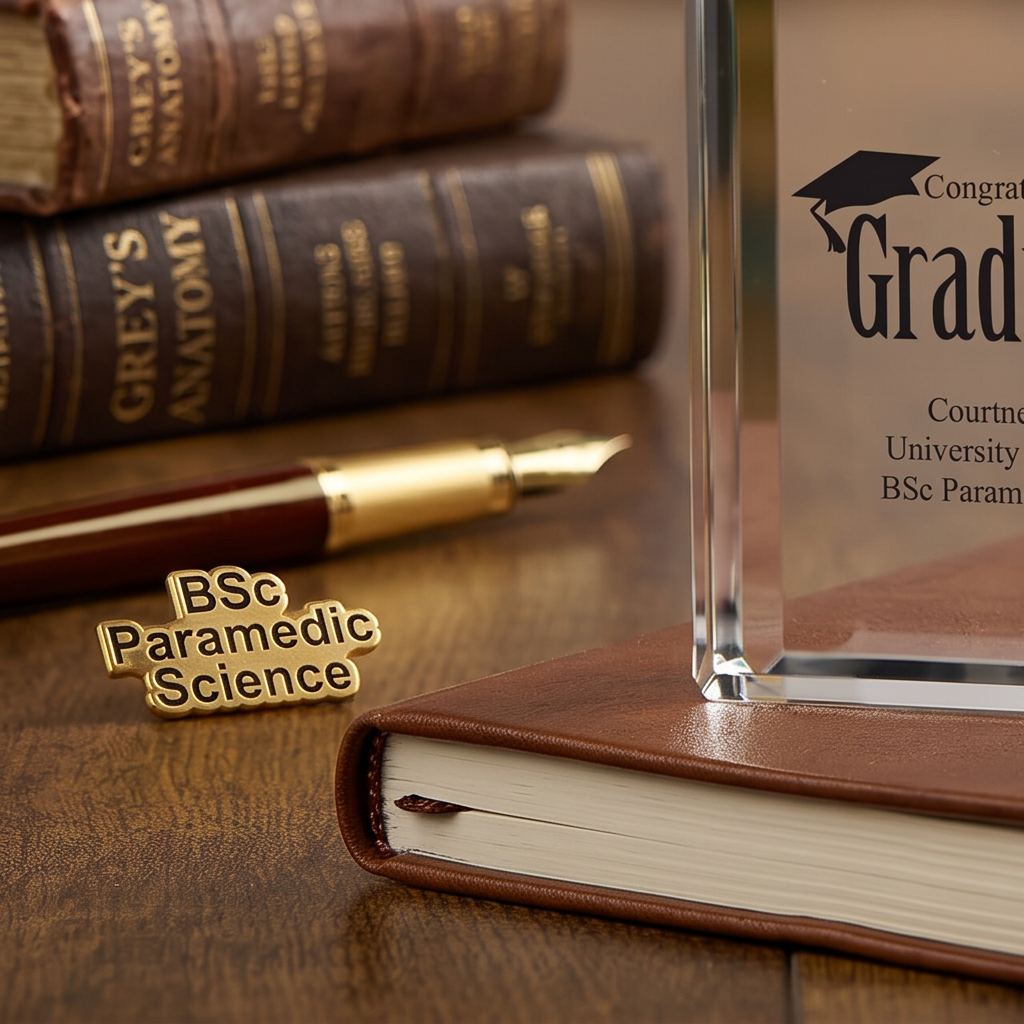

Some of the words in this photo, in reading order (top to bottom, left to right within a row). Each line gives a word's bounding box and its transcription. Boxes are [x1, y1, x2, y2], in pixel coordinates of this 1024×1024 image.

[116, 17, 154, 167] GREY'S
[102, 227, 158, 424] GREY'S
[158, 211, 216, 424] ANATOMY
[885, 435, 1020, 471] University
[880, 475, 933, 502] BSc
[179, 571, 281, 615] BSc
[106, 606, 374, 666] Paramedic
[153, 660, 351, 708] Science
